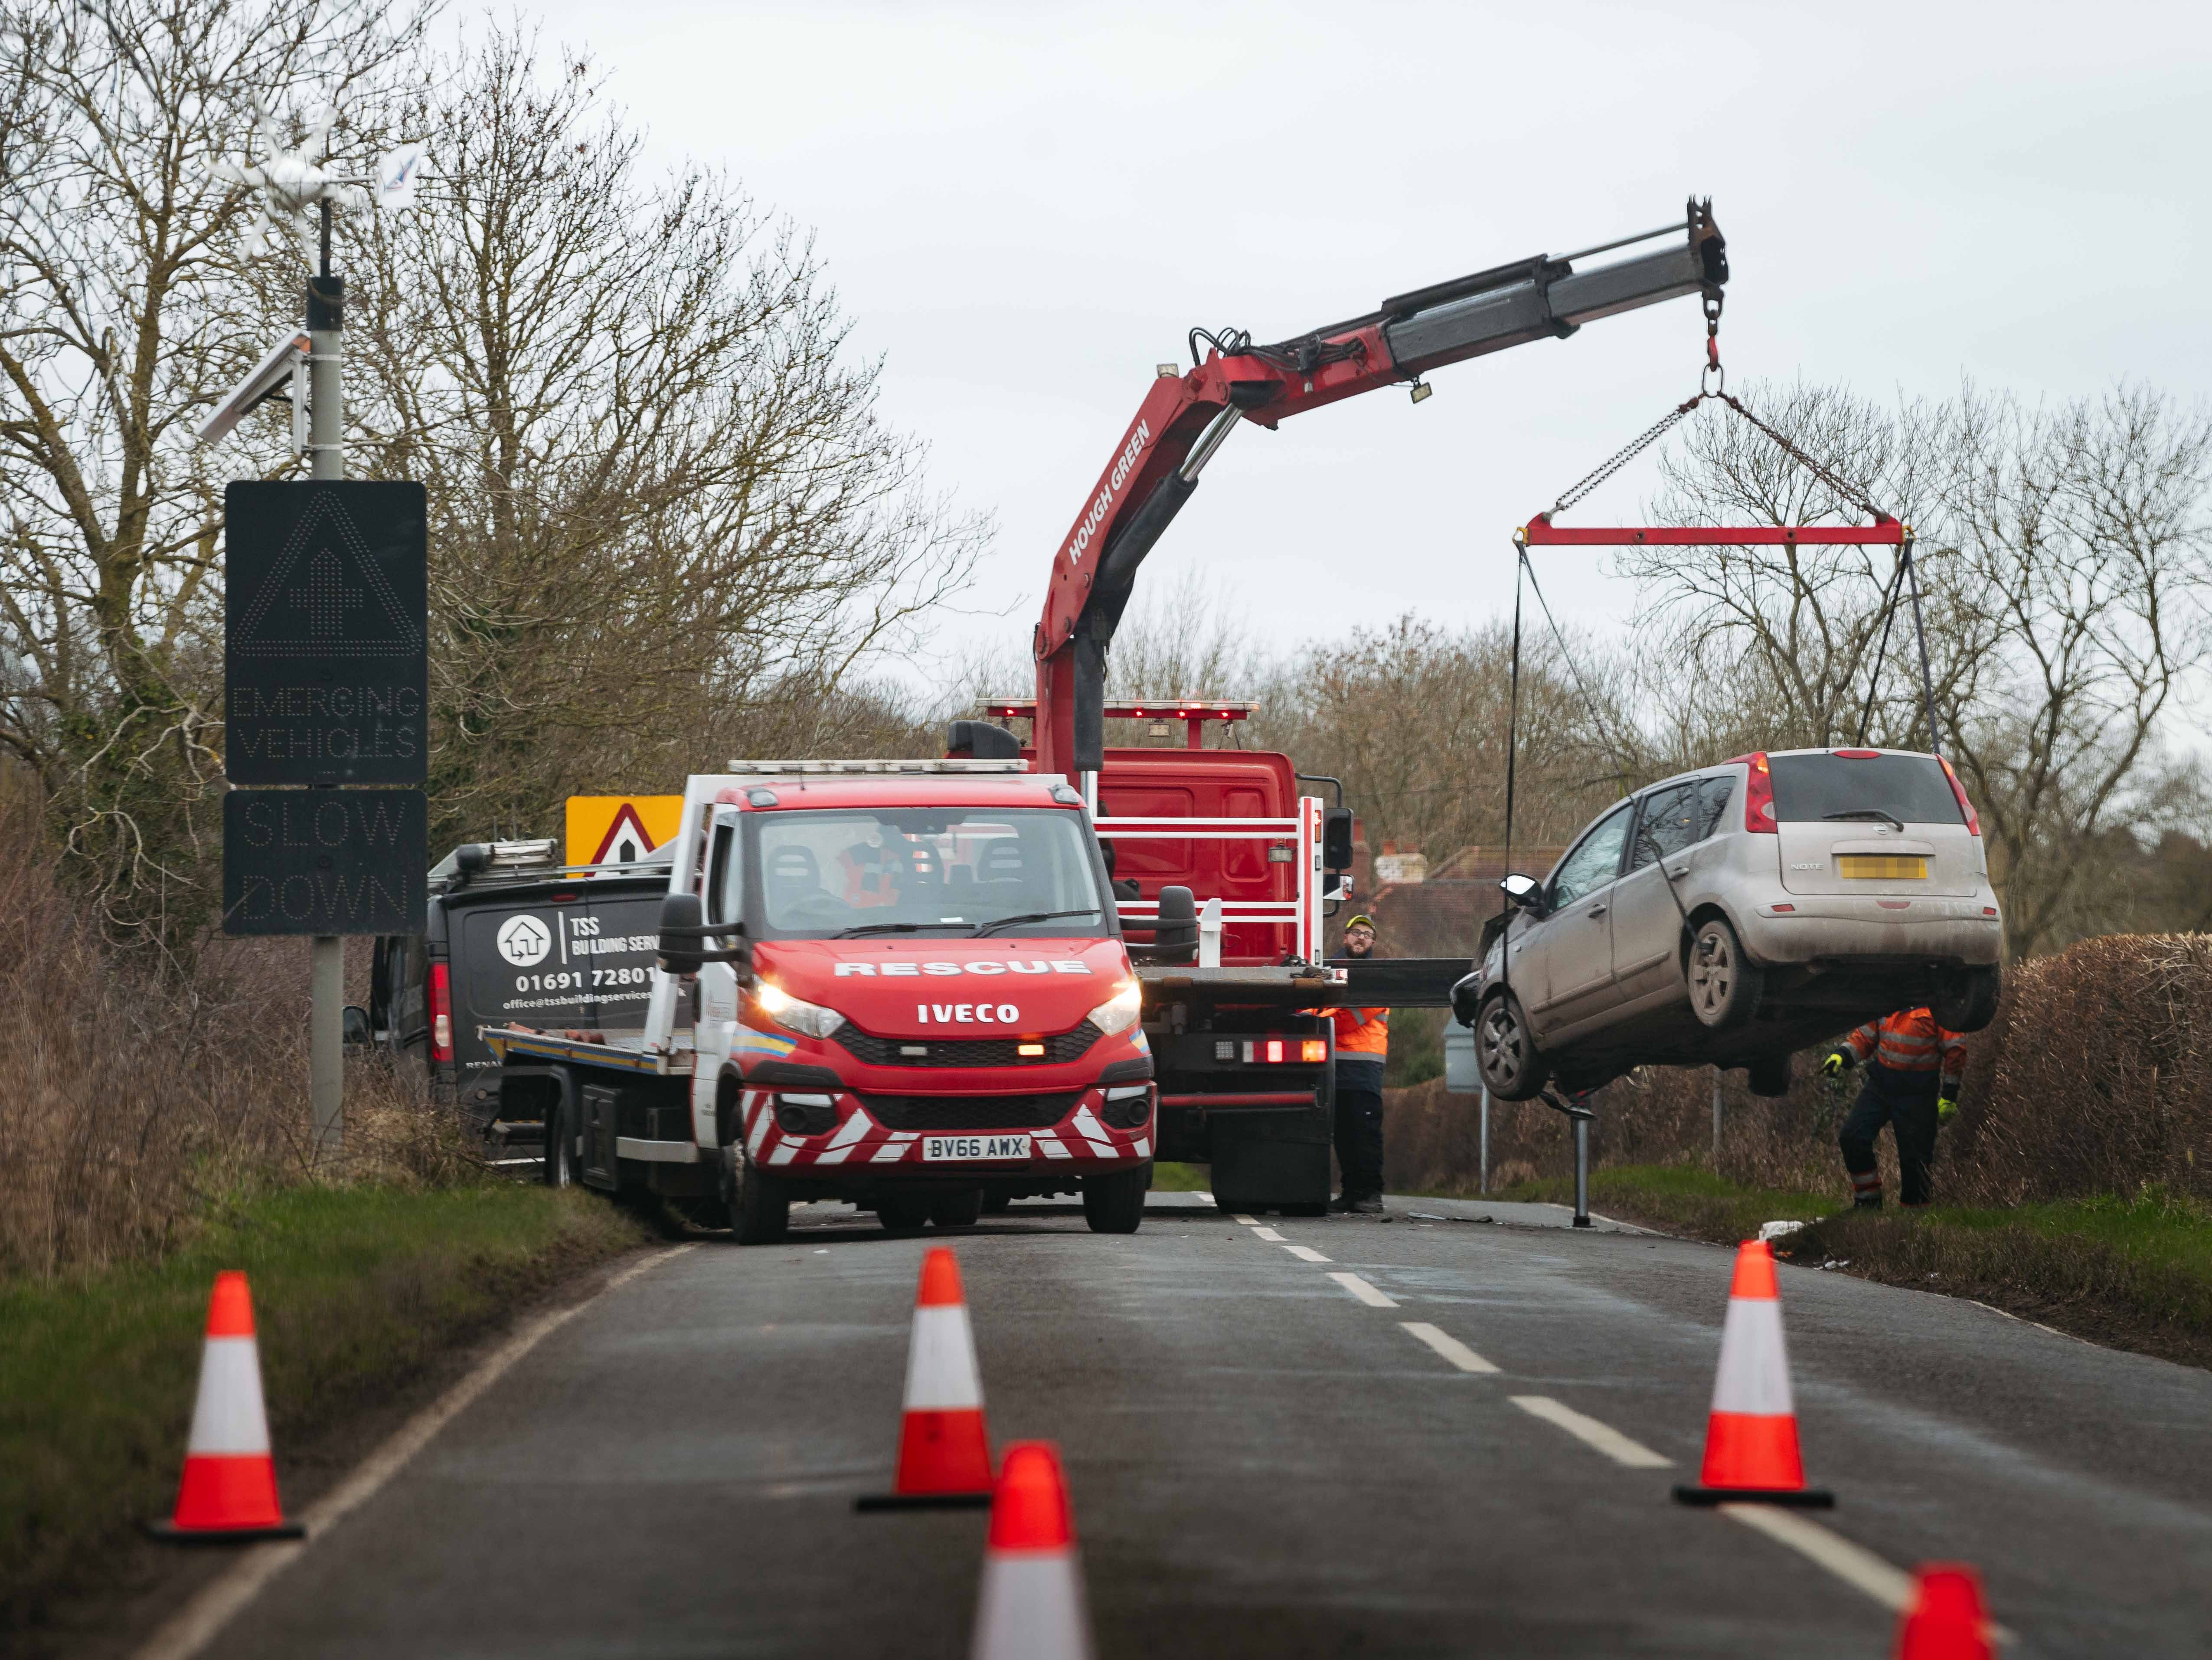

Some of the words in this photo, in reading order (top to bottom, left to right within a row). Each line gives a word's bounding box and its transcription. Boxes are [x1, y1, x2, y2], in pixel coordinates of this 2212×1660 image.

[1068, 484, 1113, 565] HOUGH
[1111, 418, 1150, 491] GREEN
[233, 687, 420, 716] EMERGING
[238, 727, 416, 758] VEHICLES
[244, 801, 407, 846] SLOW
[243, 874, 407, 920] DOWN
[570, 916, 600, 936] TSS
[572, 937, 627, 955] BUILDING
[629, 935, 660, 952] SERV
[515, 971, 582, 992] 01691
[591, 966, 655, 986] 72801
[833, 960, 1094, 977] RESCUE
[918, 1003, 1019, 1023] IVECO
[931, 1139, 980, 1157] BV66
[987, 1138, 1023, 1156] AWX
